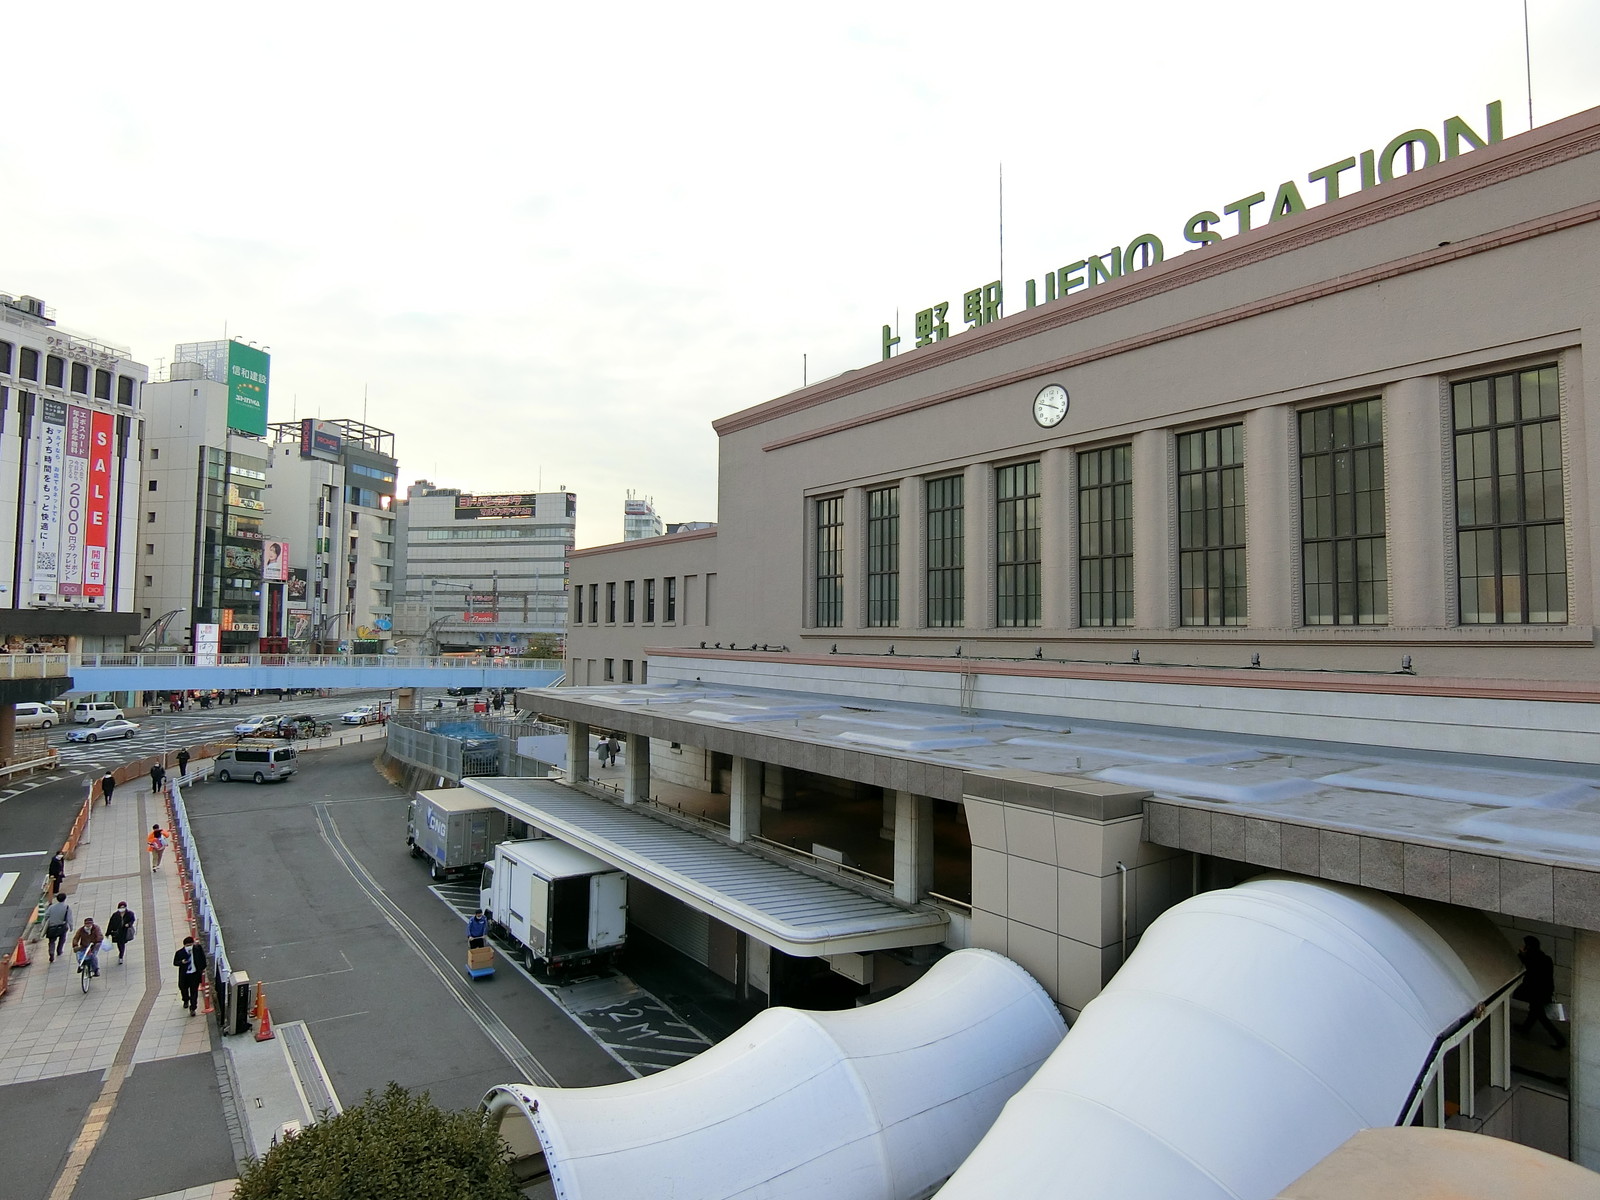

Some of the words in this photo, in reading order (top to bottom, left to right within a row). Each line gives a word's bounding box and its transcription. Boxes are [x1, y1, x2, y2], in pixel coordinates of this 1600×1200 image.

[1025, 233, 1164, 309] UENO
[1183, 100, 1503, 245] STATION
[232, 364, 267, 385] 信和建設
[79, 412, 87, 455] エポスカード
[93, 432, 107, 526] SALE
[68, 483, 81, 551] 2000円分
[90, 550, 100, 580] 開催中
[430, 816, 446, 837] CNG
